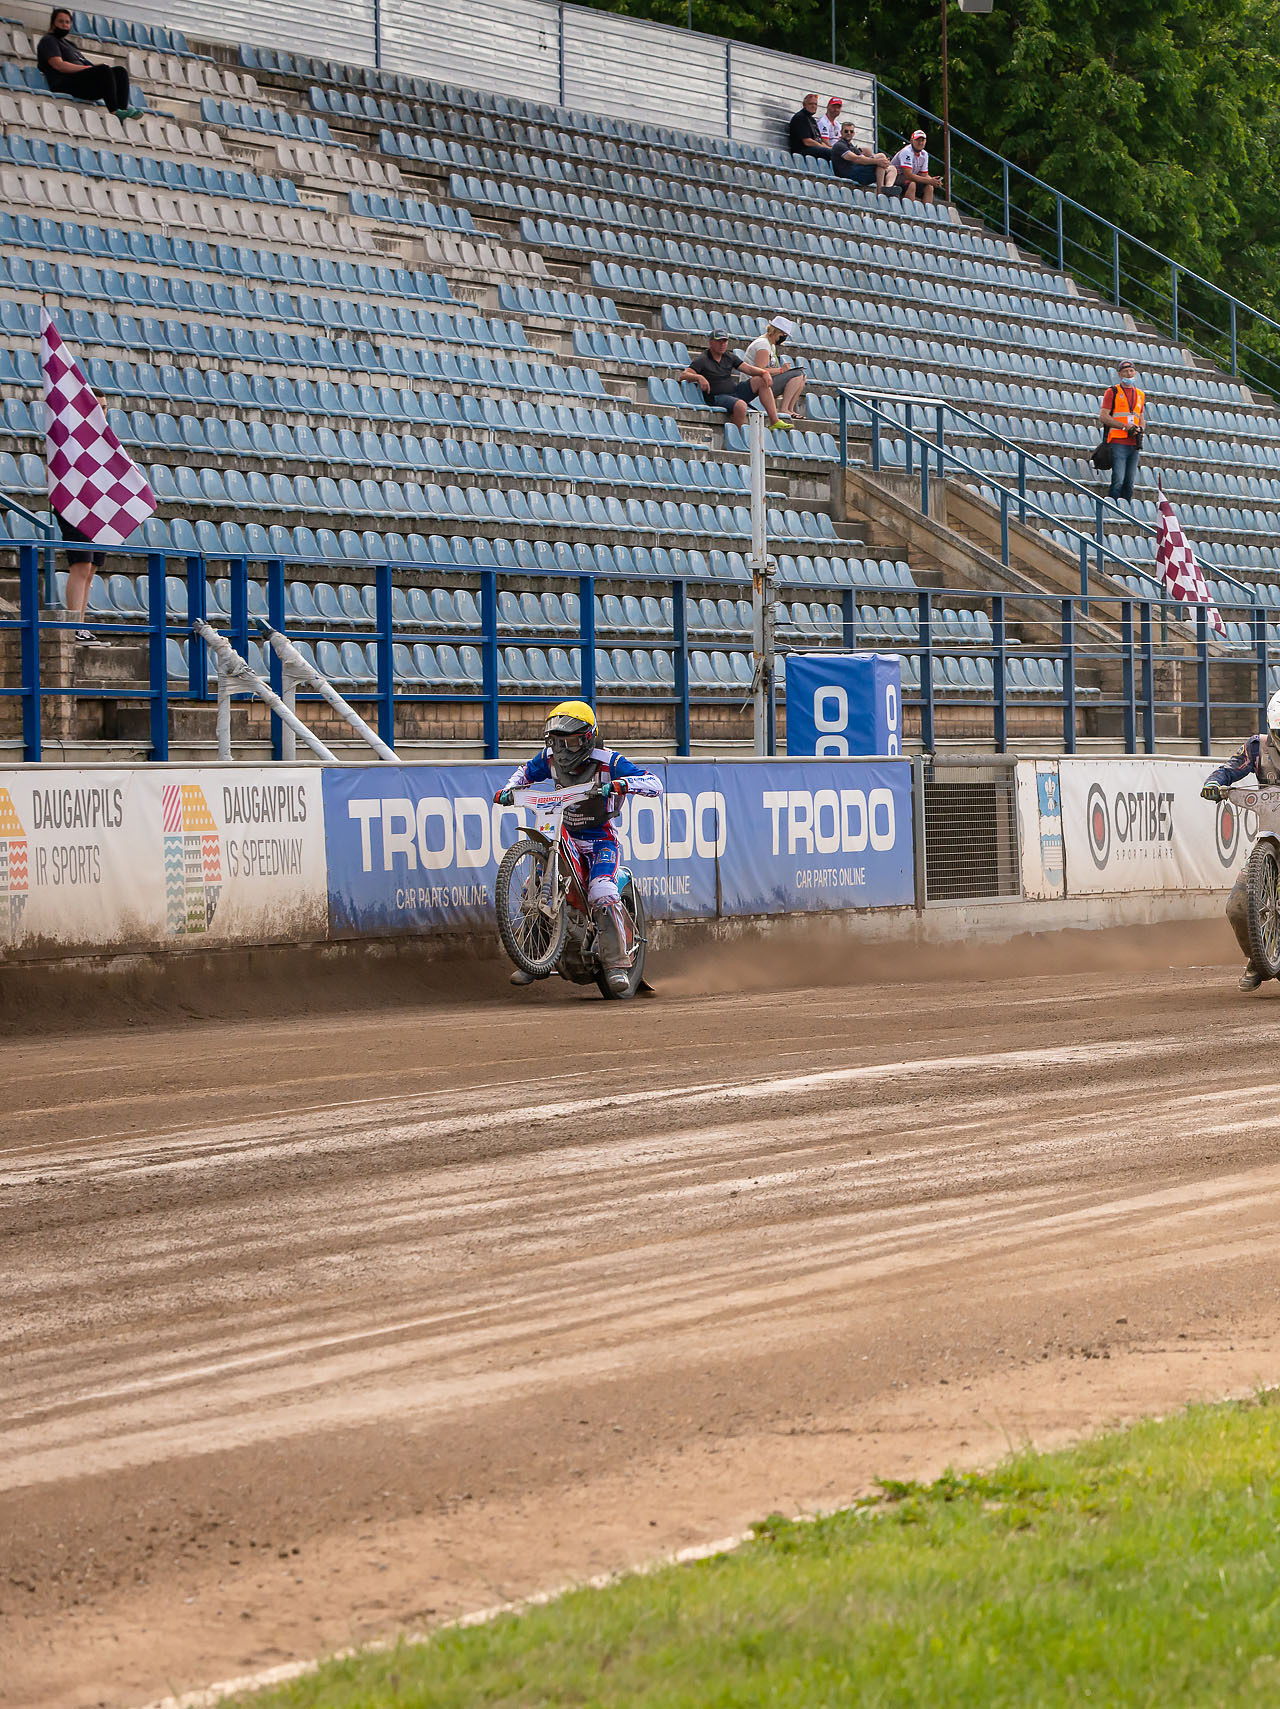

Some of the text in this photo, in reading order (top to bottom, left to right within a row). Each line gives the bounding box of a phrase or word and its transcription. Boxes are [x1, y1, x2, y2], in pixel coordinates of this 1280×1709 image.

[33, 788, 123, 829] DAUGAVPILS
[222, 785, 307, 825] DAUGAVPILS
[763, 788, 896, 856] TRODO
[1115, 791, 1175, 843] OPTIBET
[348, 796, 527, 873] TRODO
[35, 844, 101, 886] IR SPORTS
[226, 837, 304, 878] IS SPEEDWAY
[796, 867, 866, 888] CAR PARTS ONLINE
[396, 884, 487, 910] CAR PARTS ONLINE
